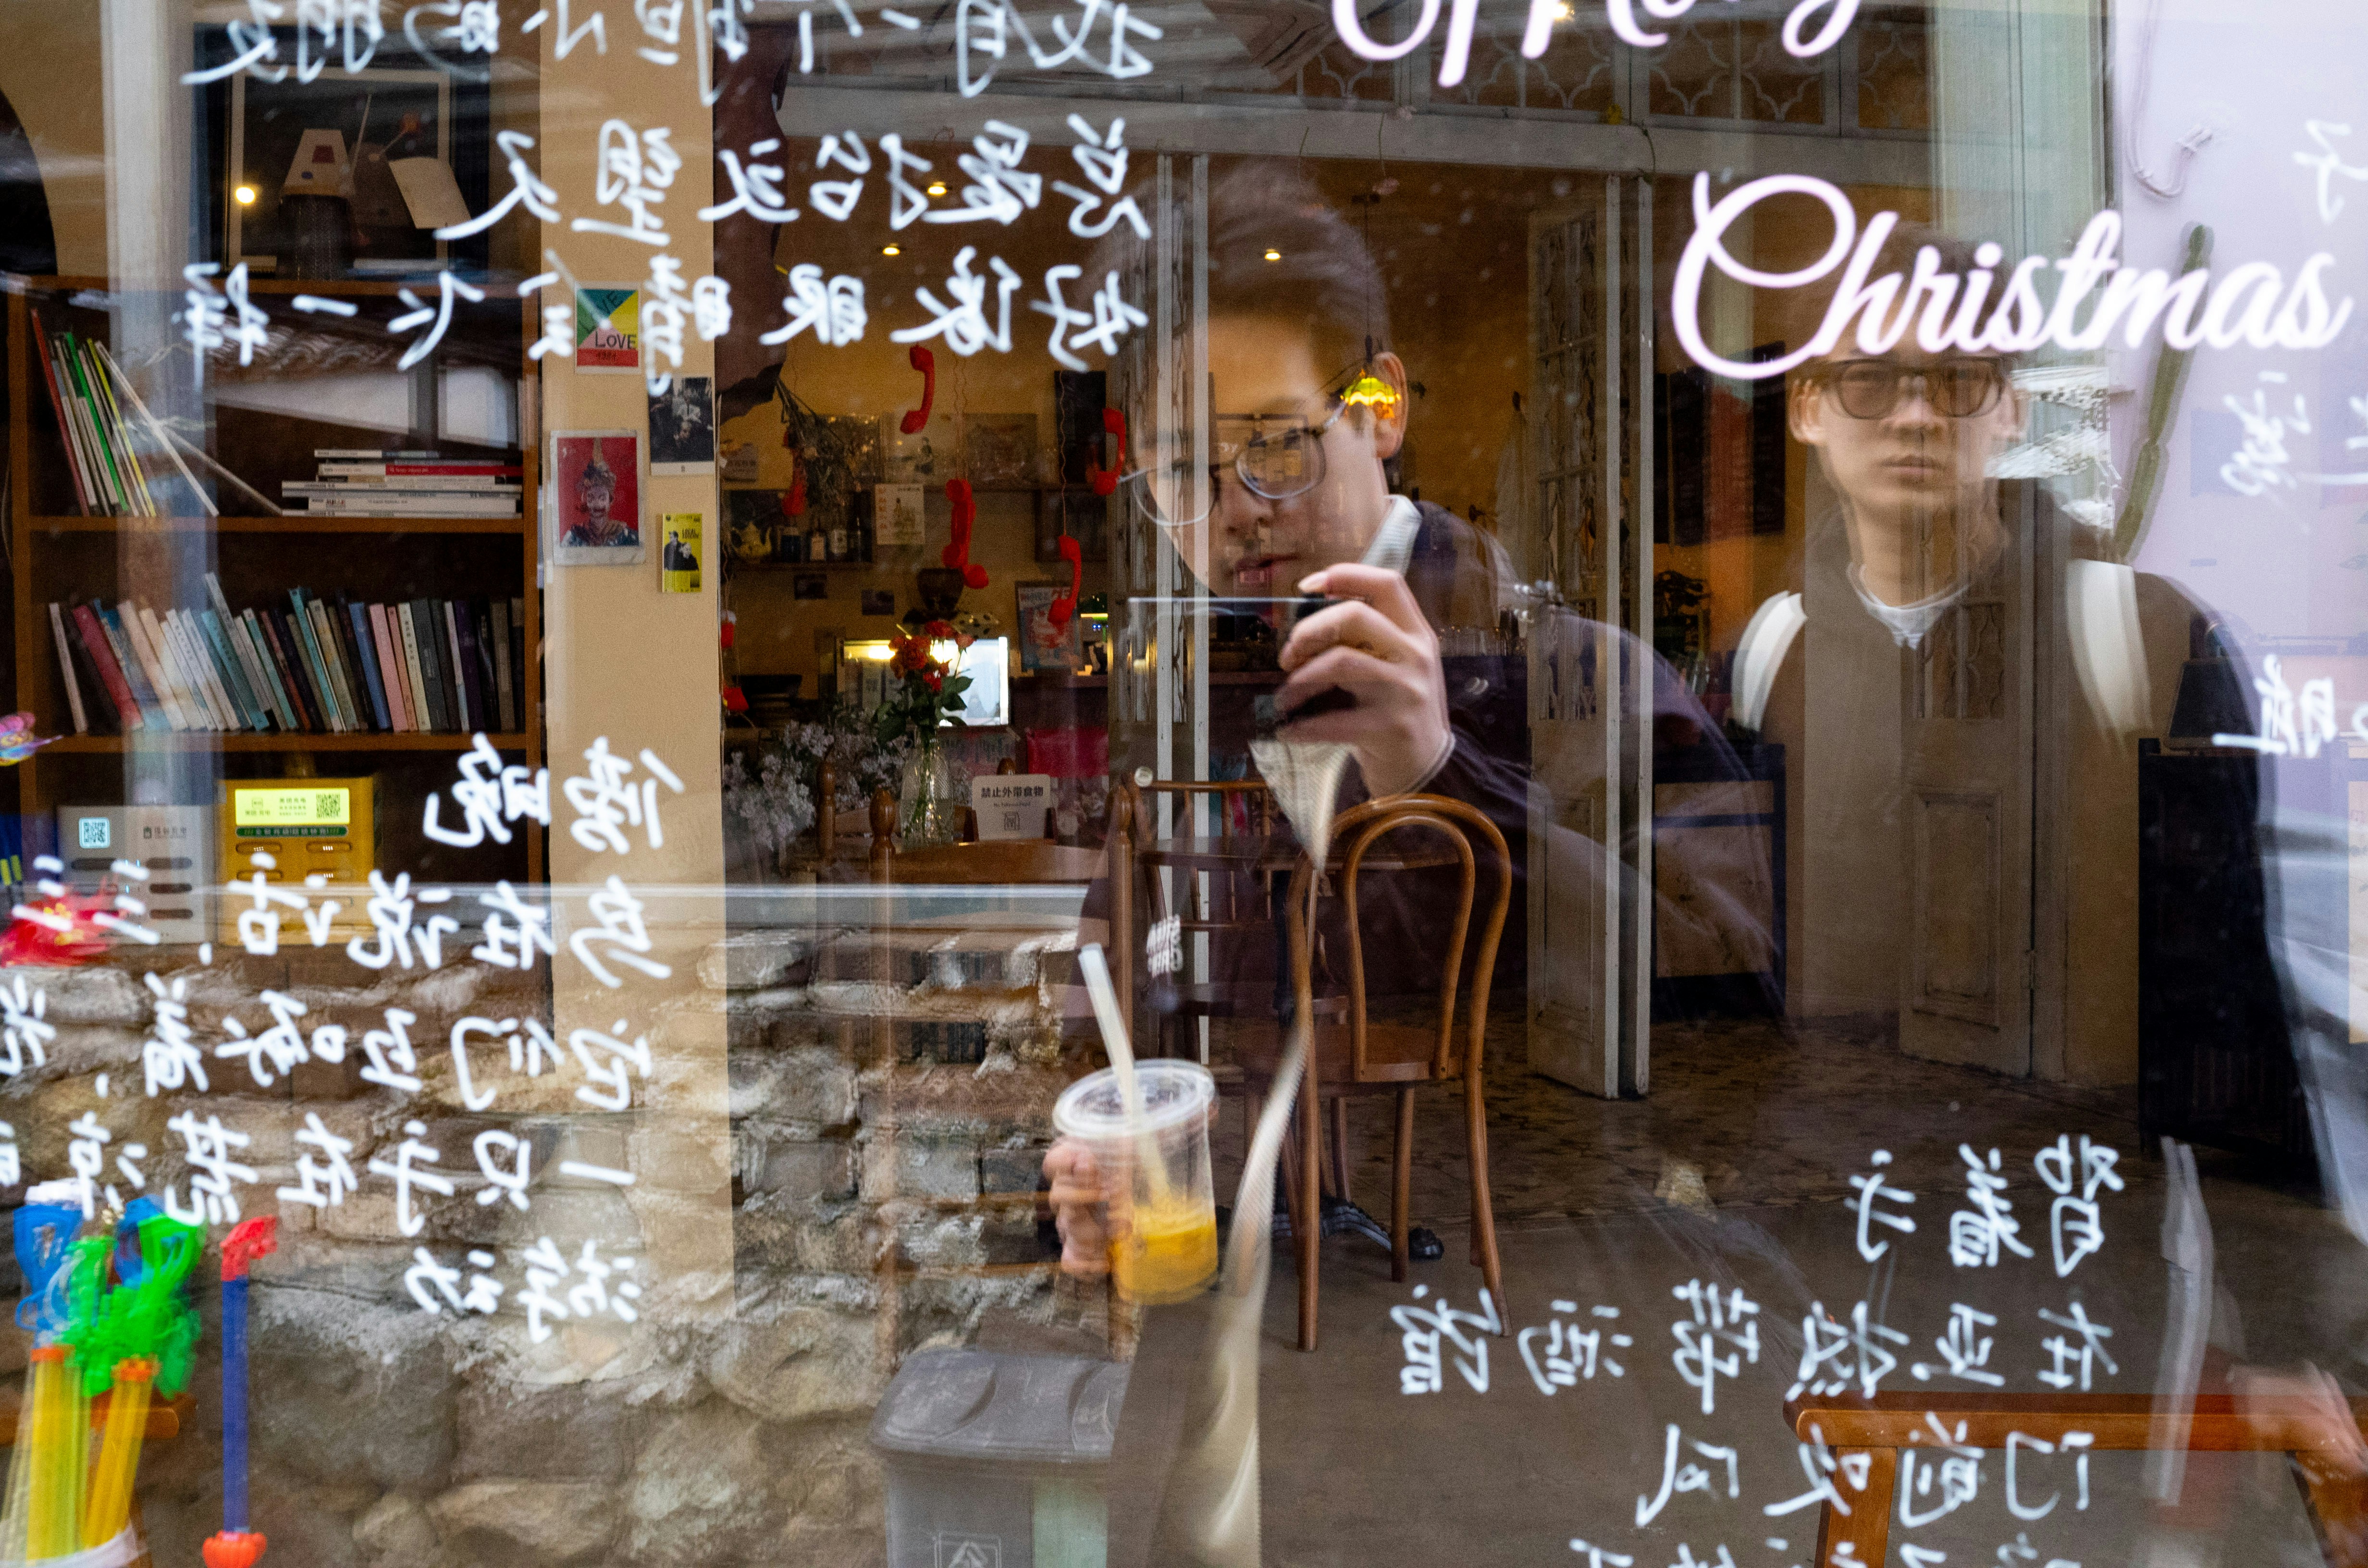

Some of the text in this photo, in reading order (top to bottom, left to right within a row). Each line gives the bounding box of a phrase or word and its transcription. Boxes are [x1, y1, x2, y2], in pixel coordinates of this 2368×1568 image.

[1672, 172, 2351, 380] Christmas
[595, 331, 636, 350] LOVE
[981, 785, 1043, 798] 禁止外带食物
